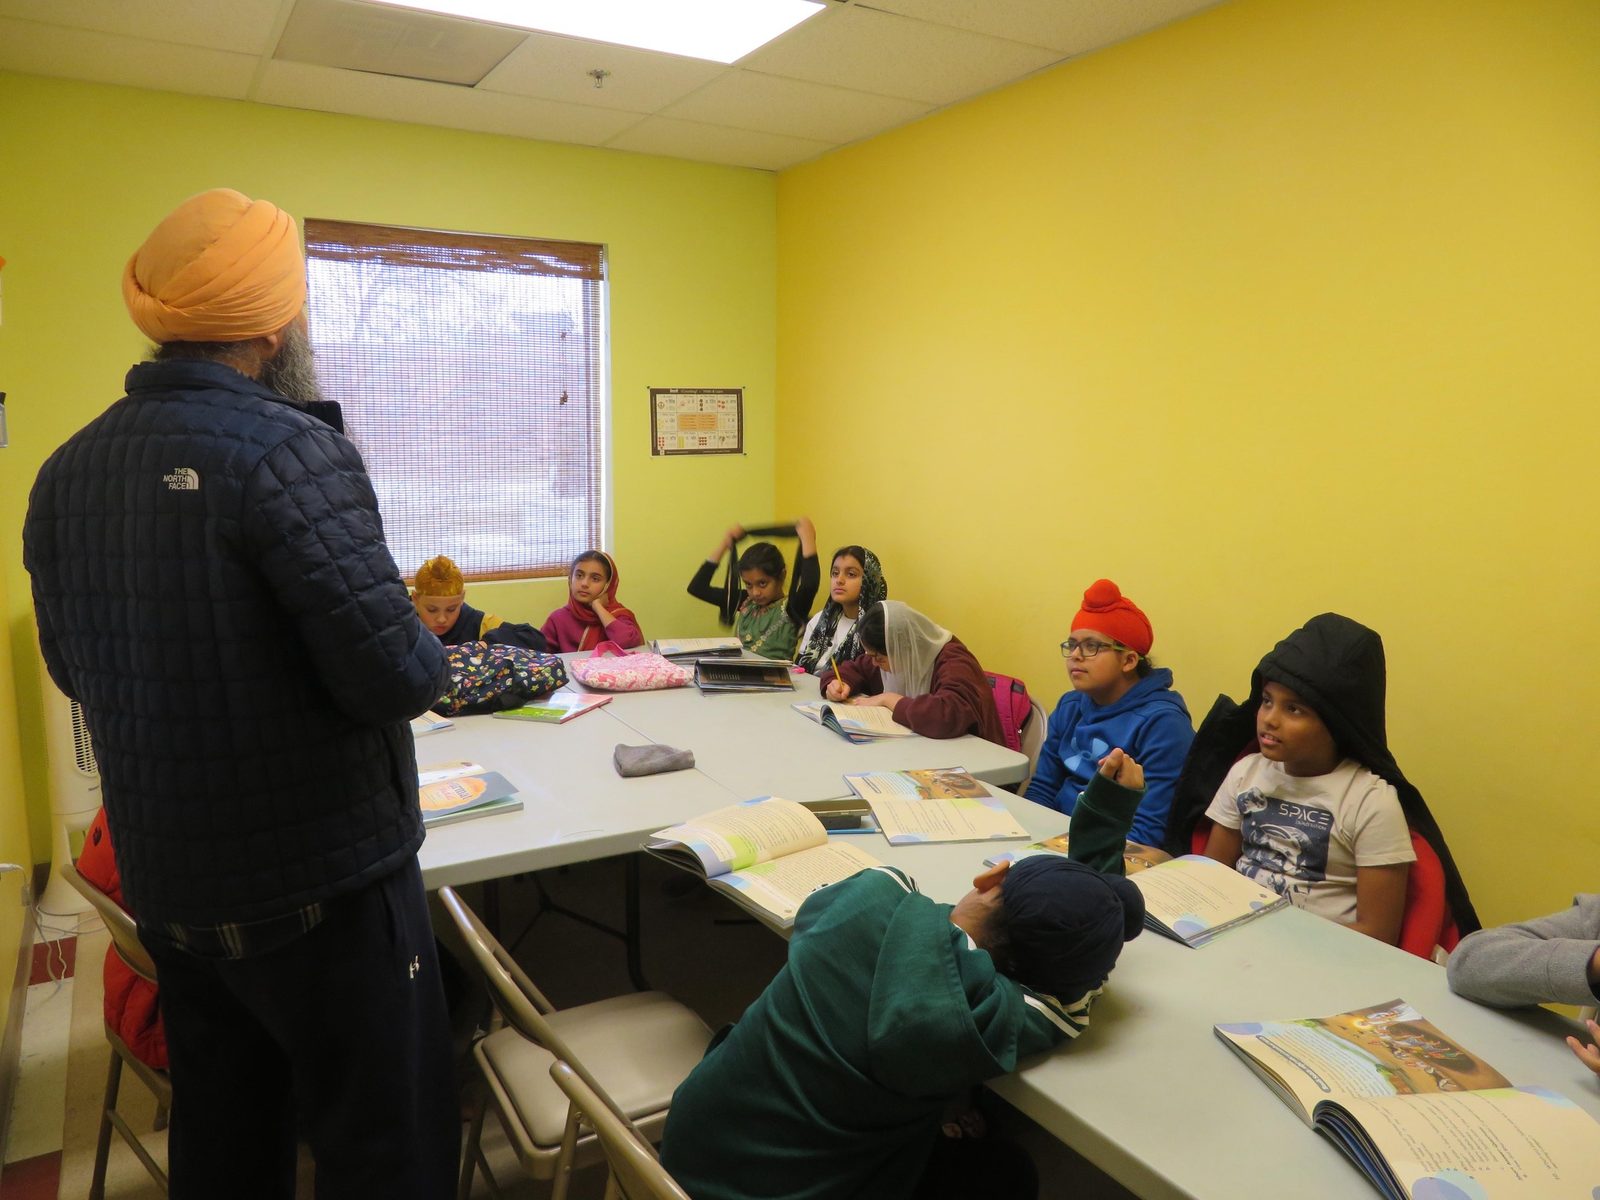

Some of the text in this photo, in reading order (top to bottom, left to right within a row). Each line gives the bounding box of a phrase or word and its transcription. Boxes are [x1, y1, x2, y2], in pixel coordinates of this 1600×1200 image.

[162, 474, 187, 482] NORTH
[168, 482, 187, 490] FACE
[1278, 803, 1331, 826] SPACE
